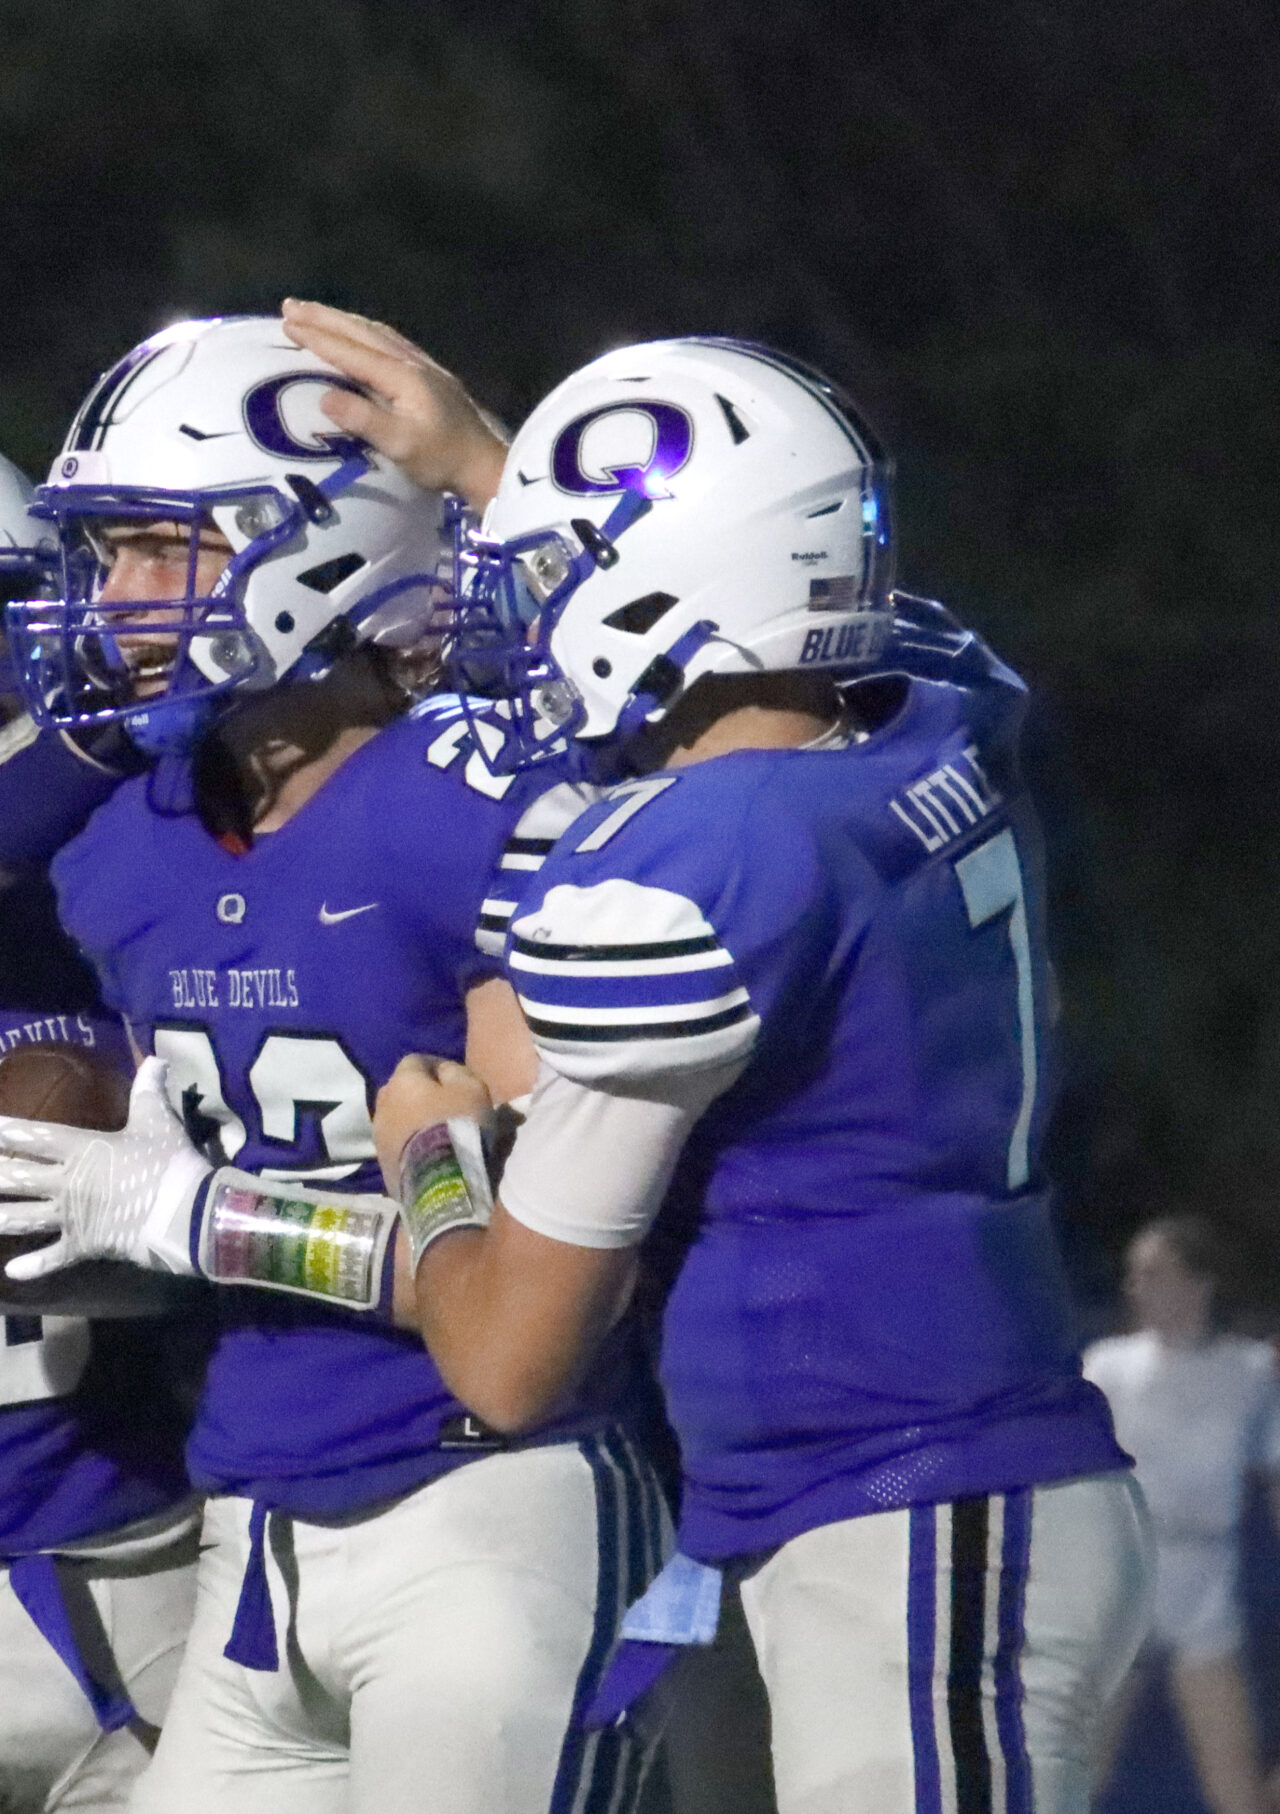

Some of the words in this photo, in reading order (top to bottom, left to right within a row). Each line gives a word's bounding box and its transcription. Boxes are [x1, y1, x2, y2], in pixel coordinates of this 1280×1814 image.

[550, 398, 695, 498] Q
[574, 777, 678, 853] 7
[216, 892, 246, 924] Q
[168, 969, 219, 1008] BLUE
[227, 969, 299, 1008] DEVILS
[954, 827, 1037, 1191] 7
[464, 1417, 480, 1437] L
